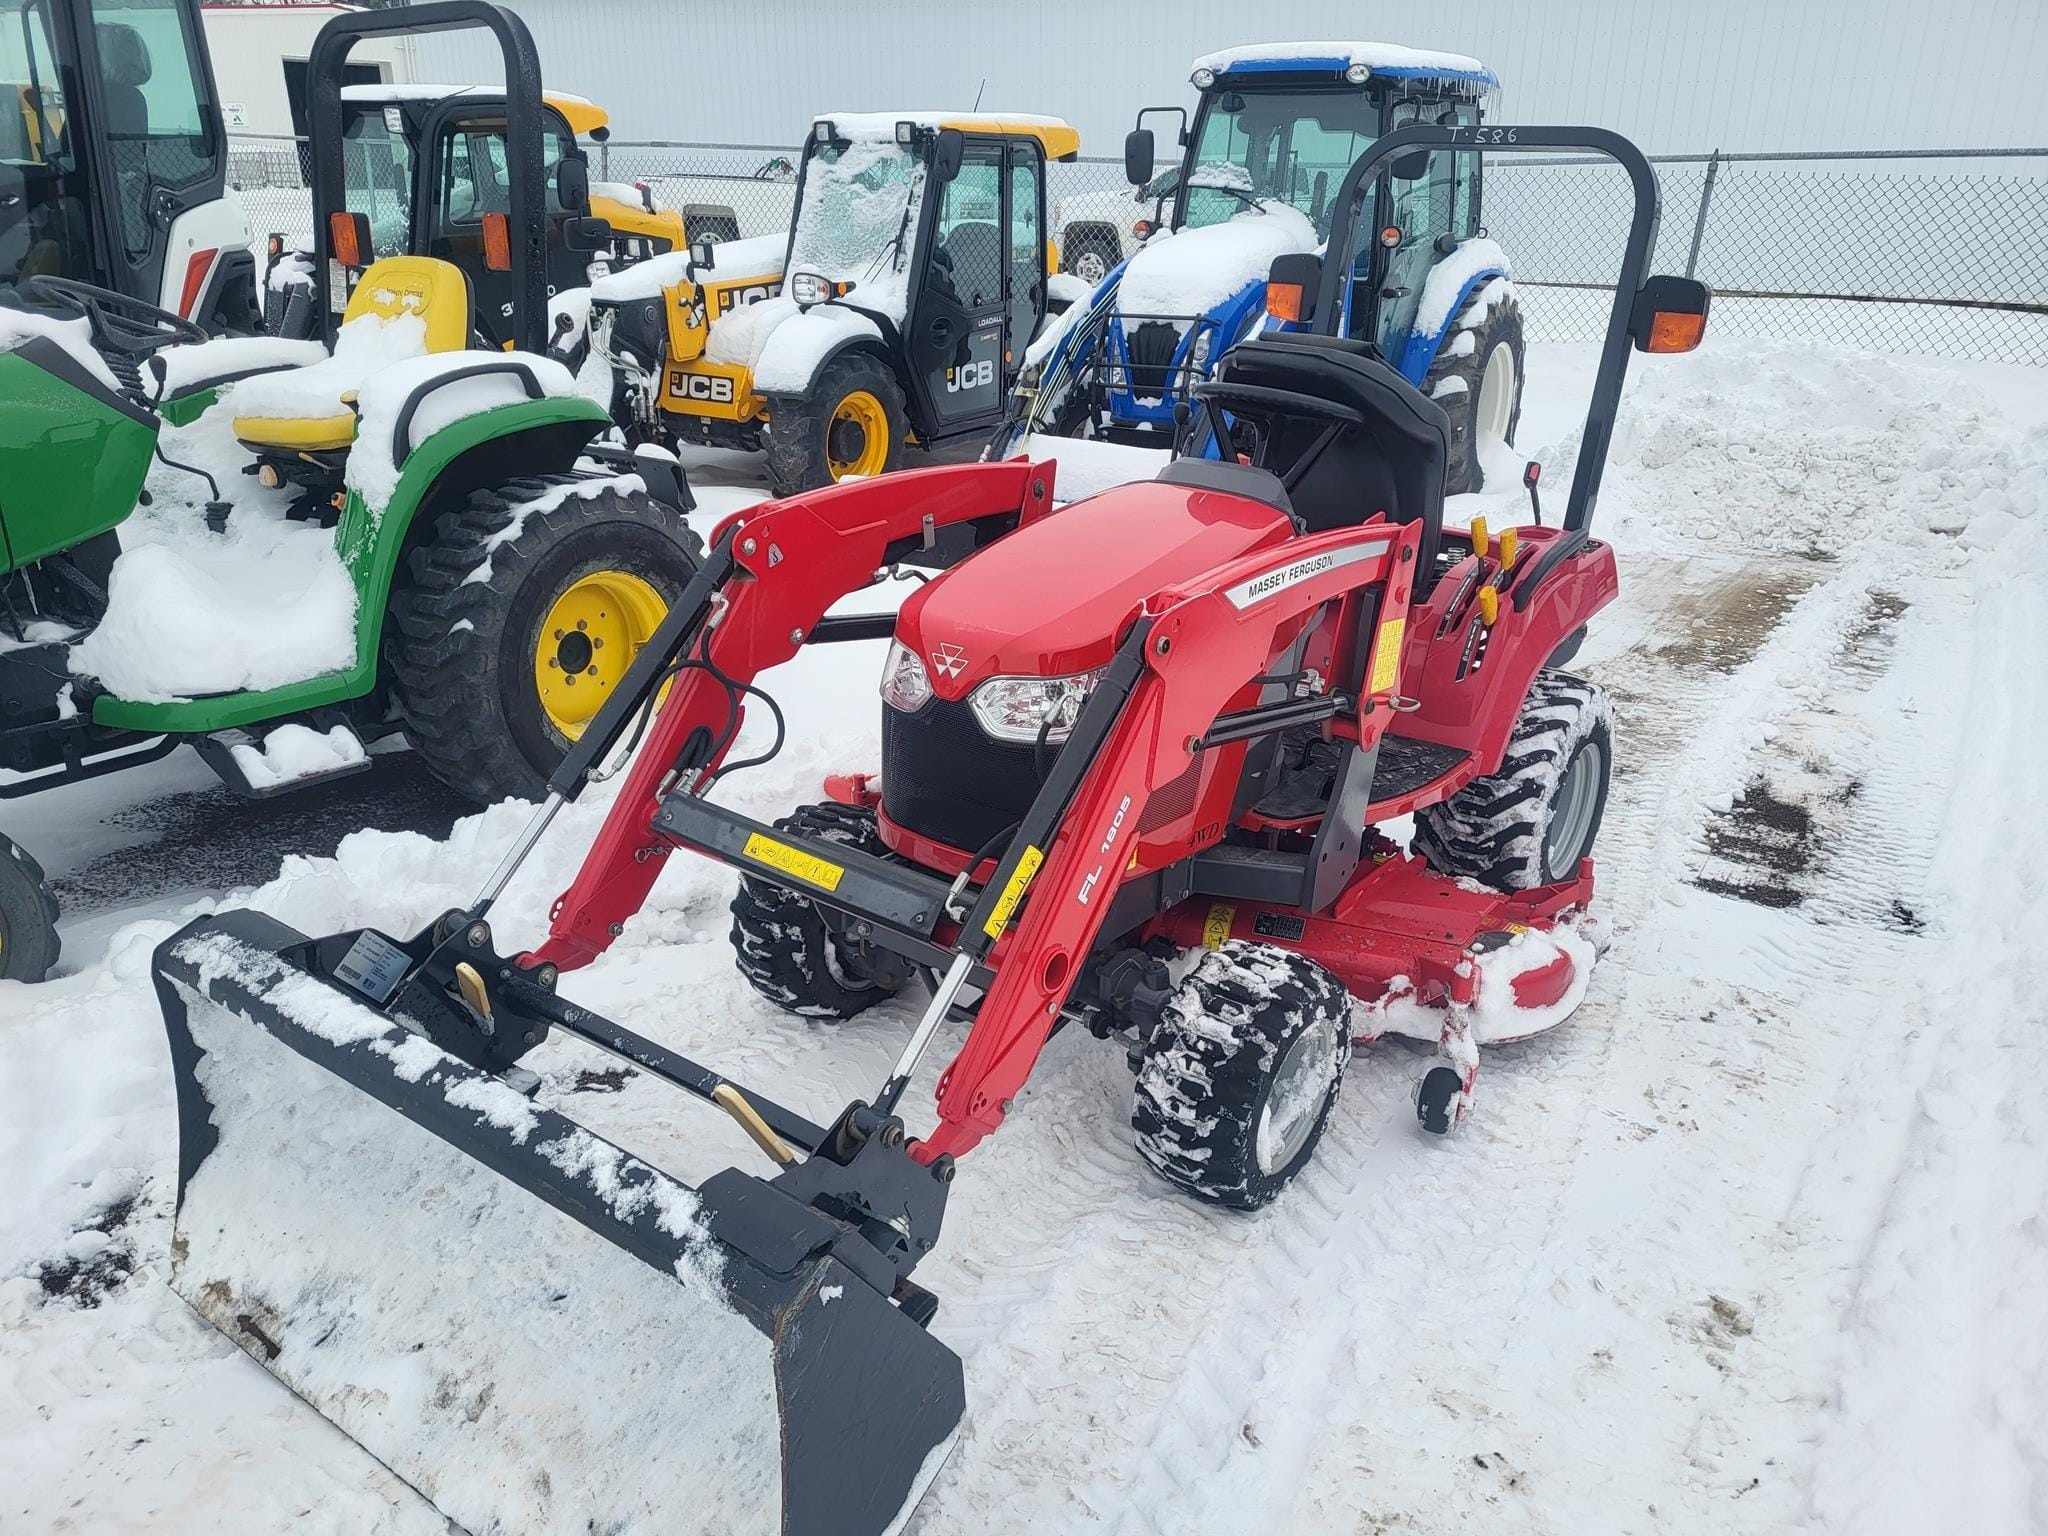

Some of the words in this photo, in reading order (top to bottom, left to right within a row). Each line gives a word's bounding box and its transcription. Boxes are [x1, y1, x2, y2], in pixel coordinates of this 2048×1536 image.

[977, 315, 1003, 327] LOADALL
[671, 374, 733, 402] JCB
[947, 360, 994, 393] JCB
[1248, 571, 1287, 599] MASSEY
[1288, 555, 1335, 581] FERGUSON
[1077, 865, 1103, 905] FL
[1101, 795, 1131, 854] 1805
[1187, 822, 1220, 849] 4WD
